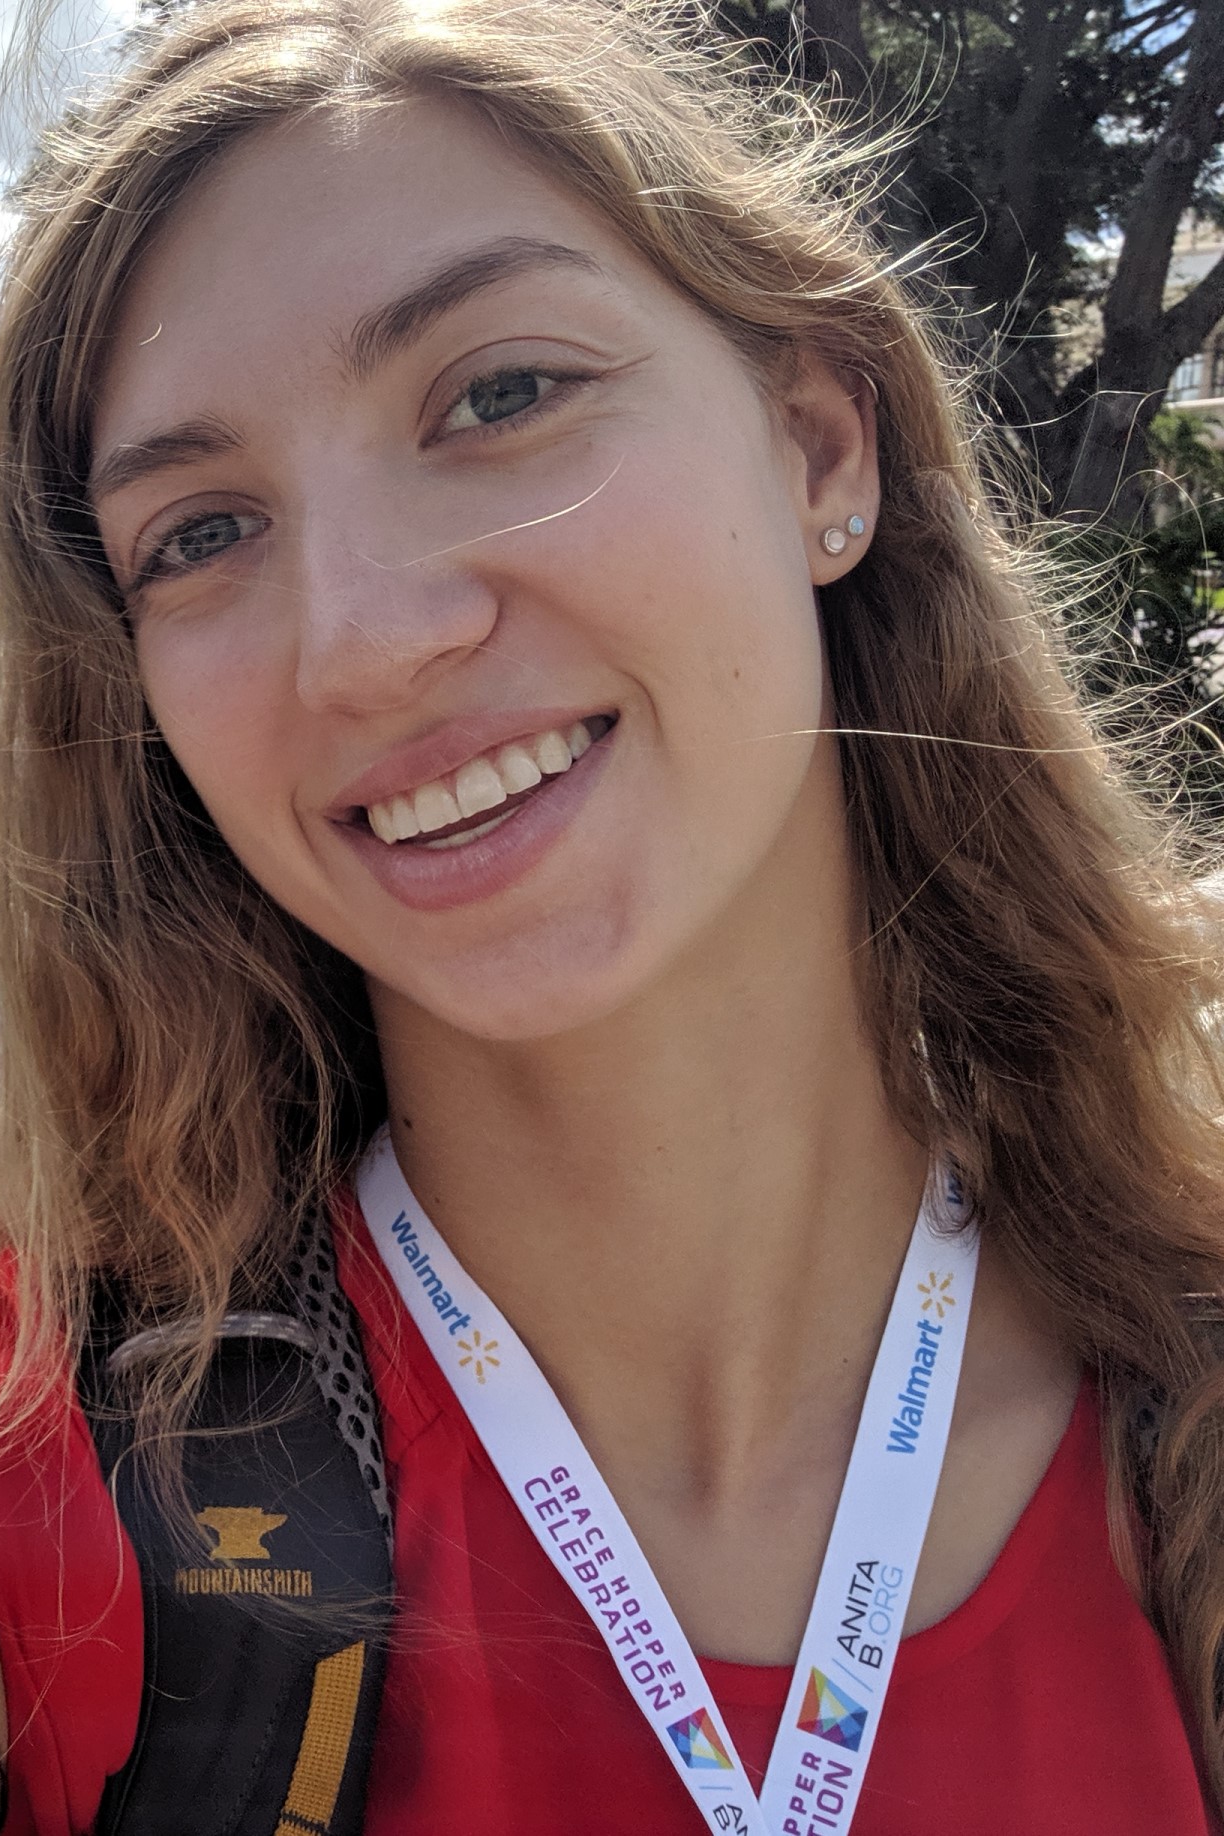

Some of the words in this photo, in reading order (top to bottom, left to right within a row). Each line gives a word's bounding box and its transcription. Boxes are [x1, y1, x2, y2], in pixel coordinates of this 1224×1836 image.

[391, 1209, 472, 1336] Walmart
[886, 1319, 944, 1454] Walmart
[175, 1567, 313, 1598] MOUNTAINSMITH
[524, 1477, 672, 1712] CELEBRATION
[549, 1465, 615, 1566] GRACE
[610, 1575, 687, 1701] HOPPER
[836, 1560, 880, 1659] ANITA
[857, 1564, 904, 1670] B.ORG
